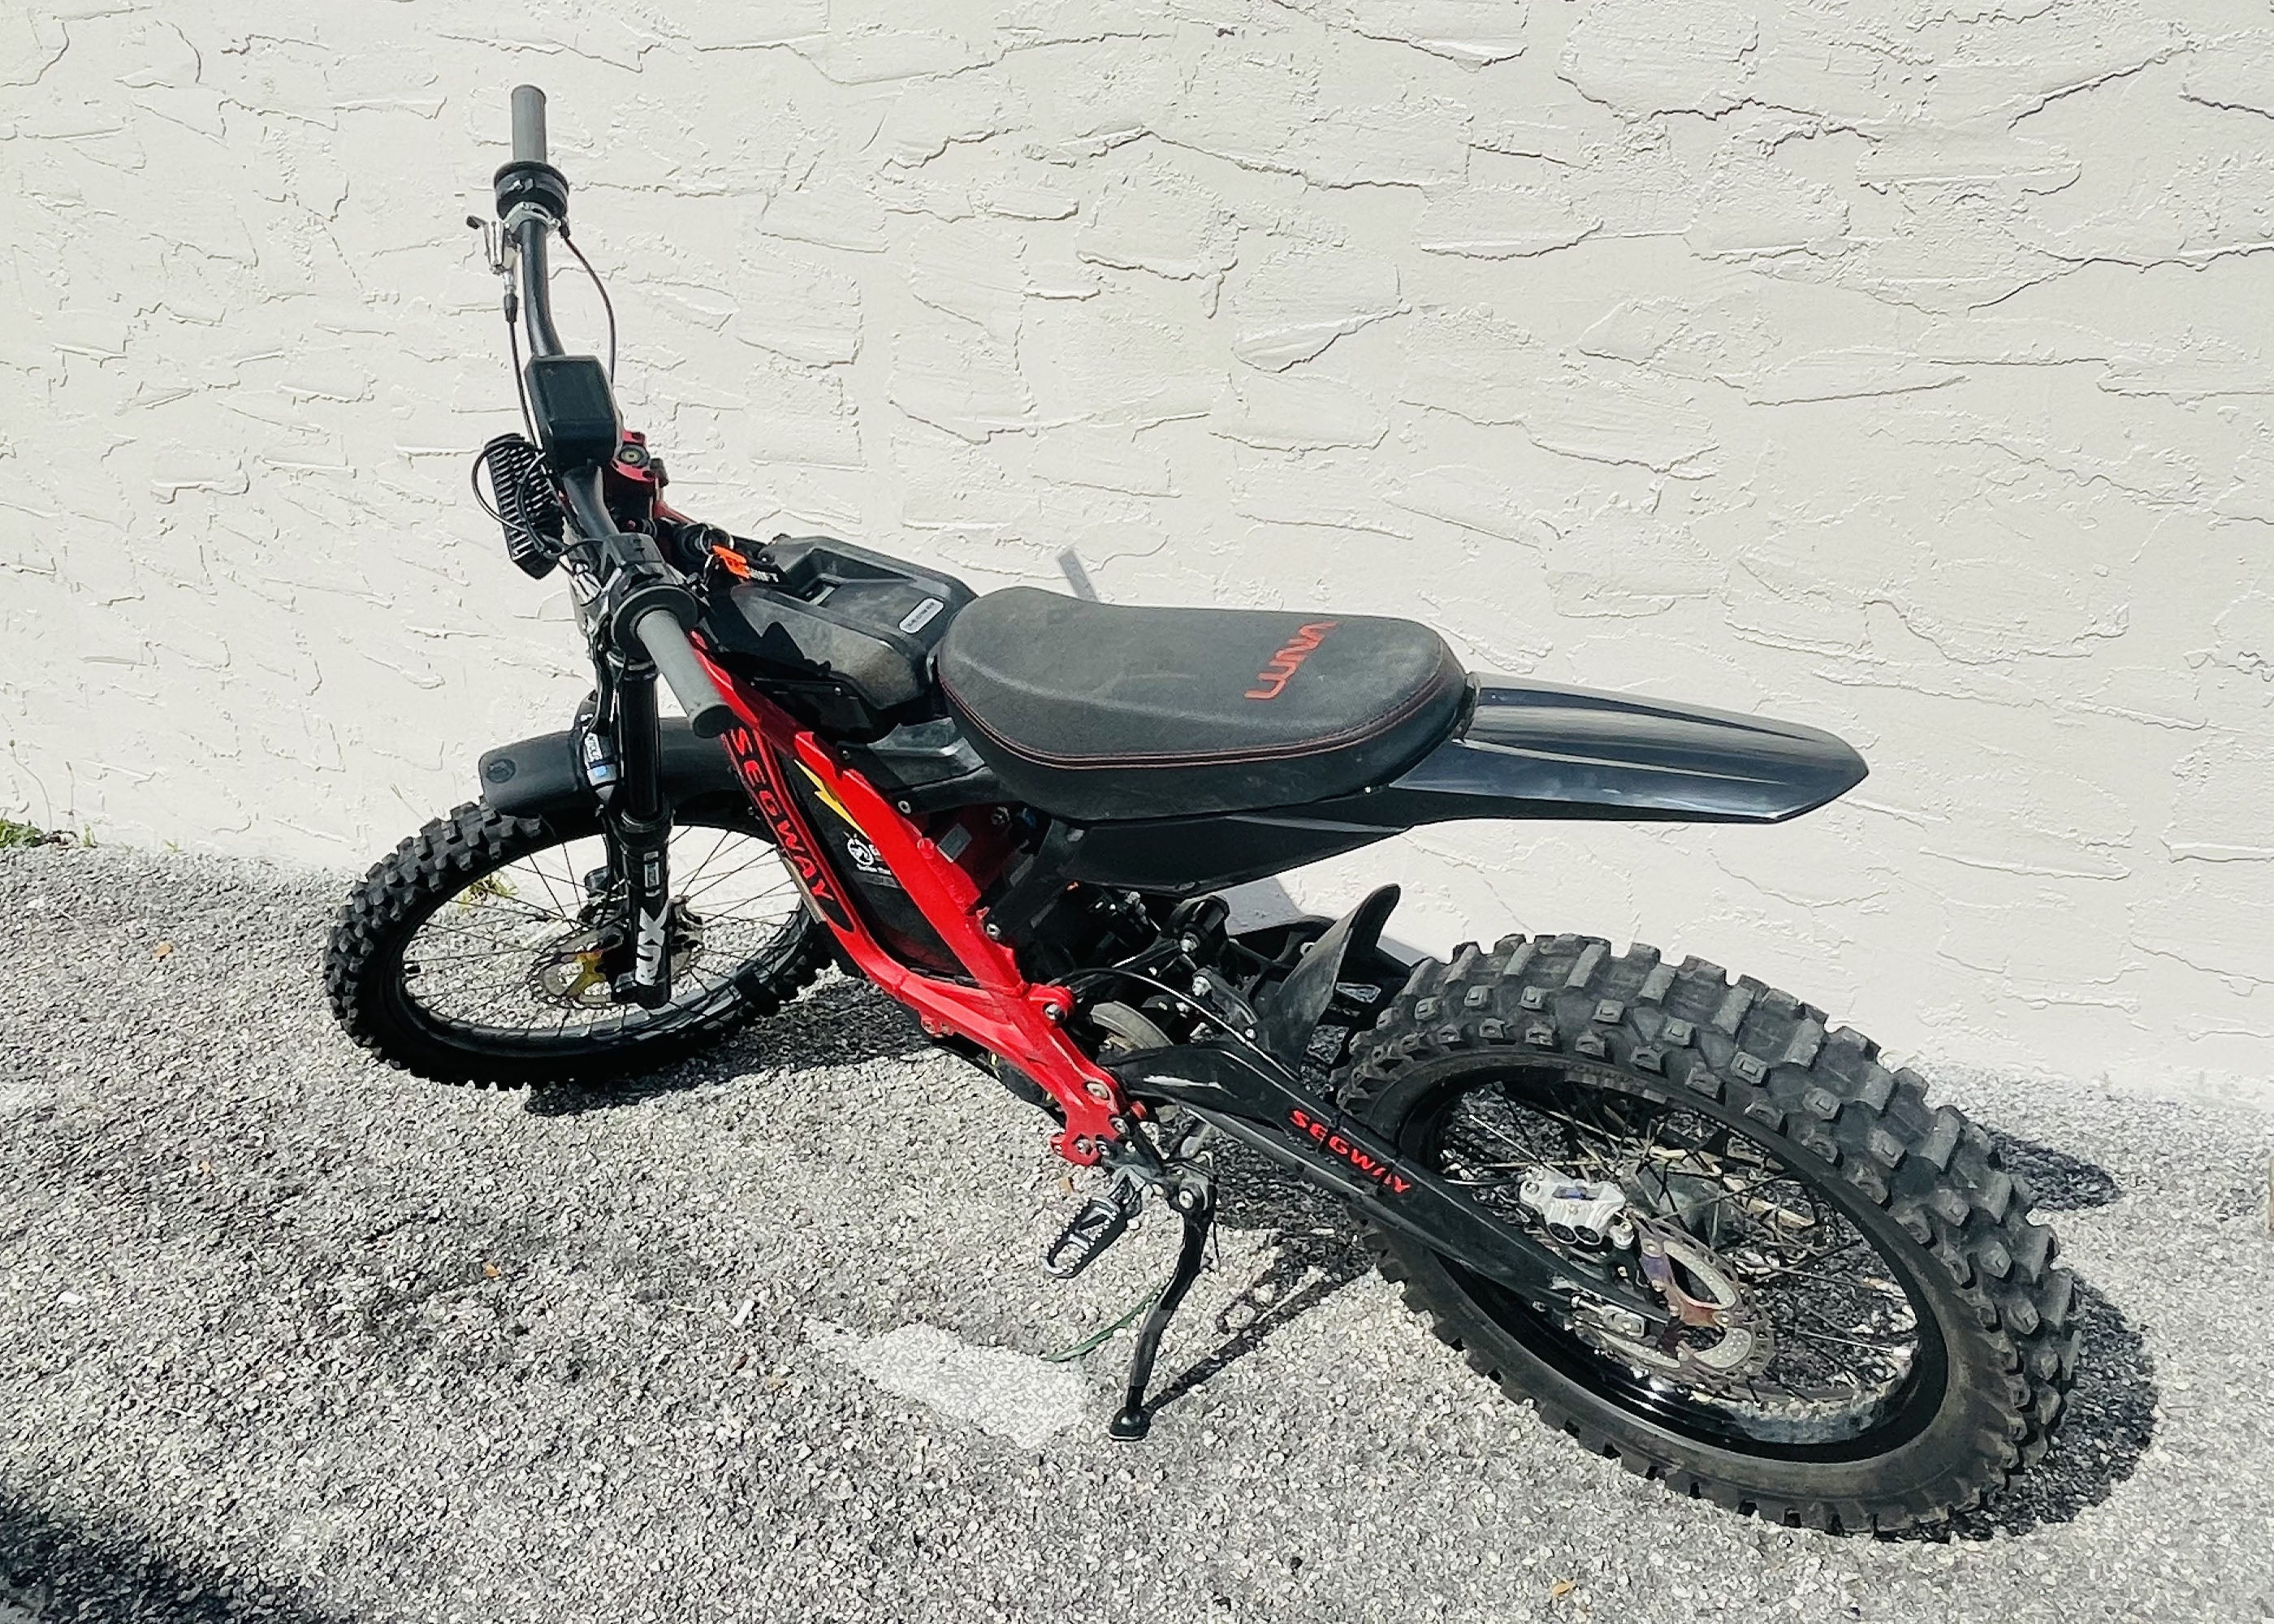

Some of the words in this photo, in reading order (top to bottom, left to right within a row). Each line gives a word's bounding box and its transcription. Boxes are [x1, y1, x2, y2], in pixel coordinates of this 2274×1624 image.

[730, 727, 835, 901] SEGWAY
[634, 898, 669, 987] RUX
[1289, 1109, 1412, 1194] SEGWAY
